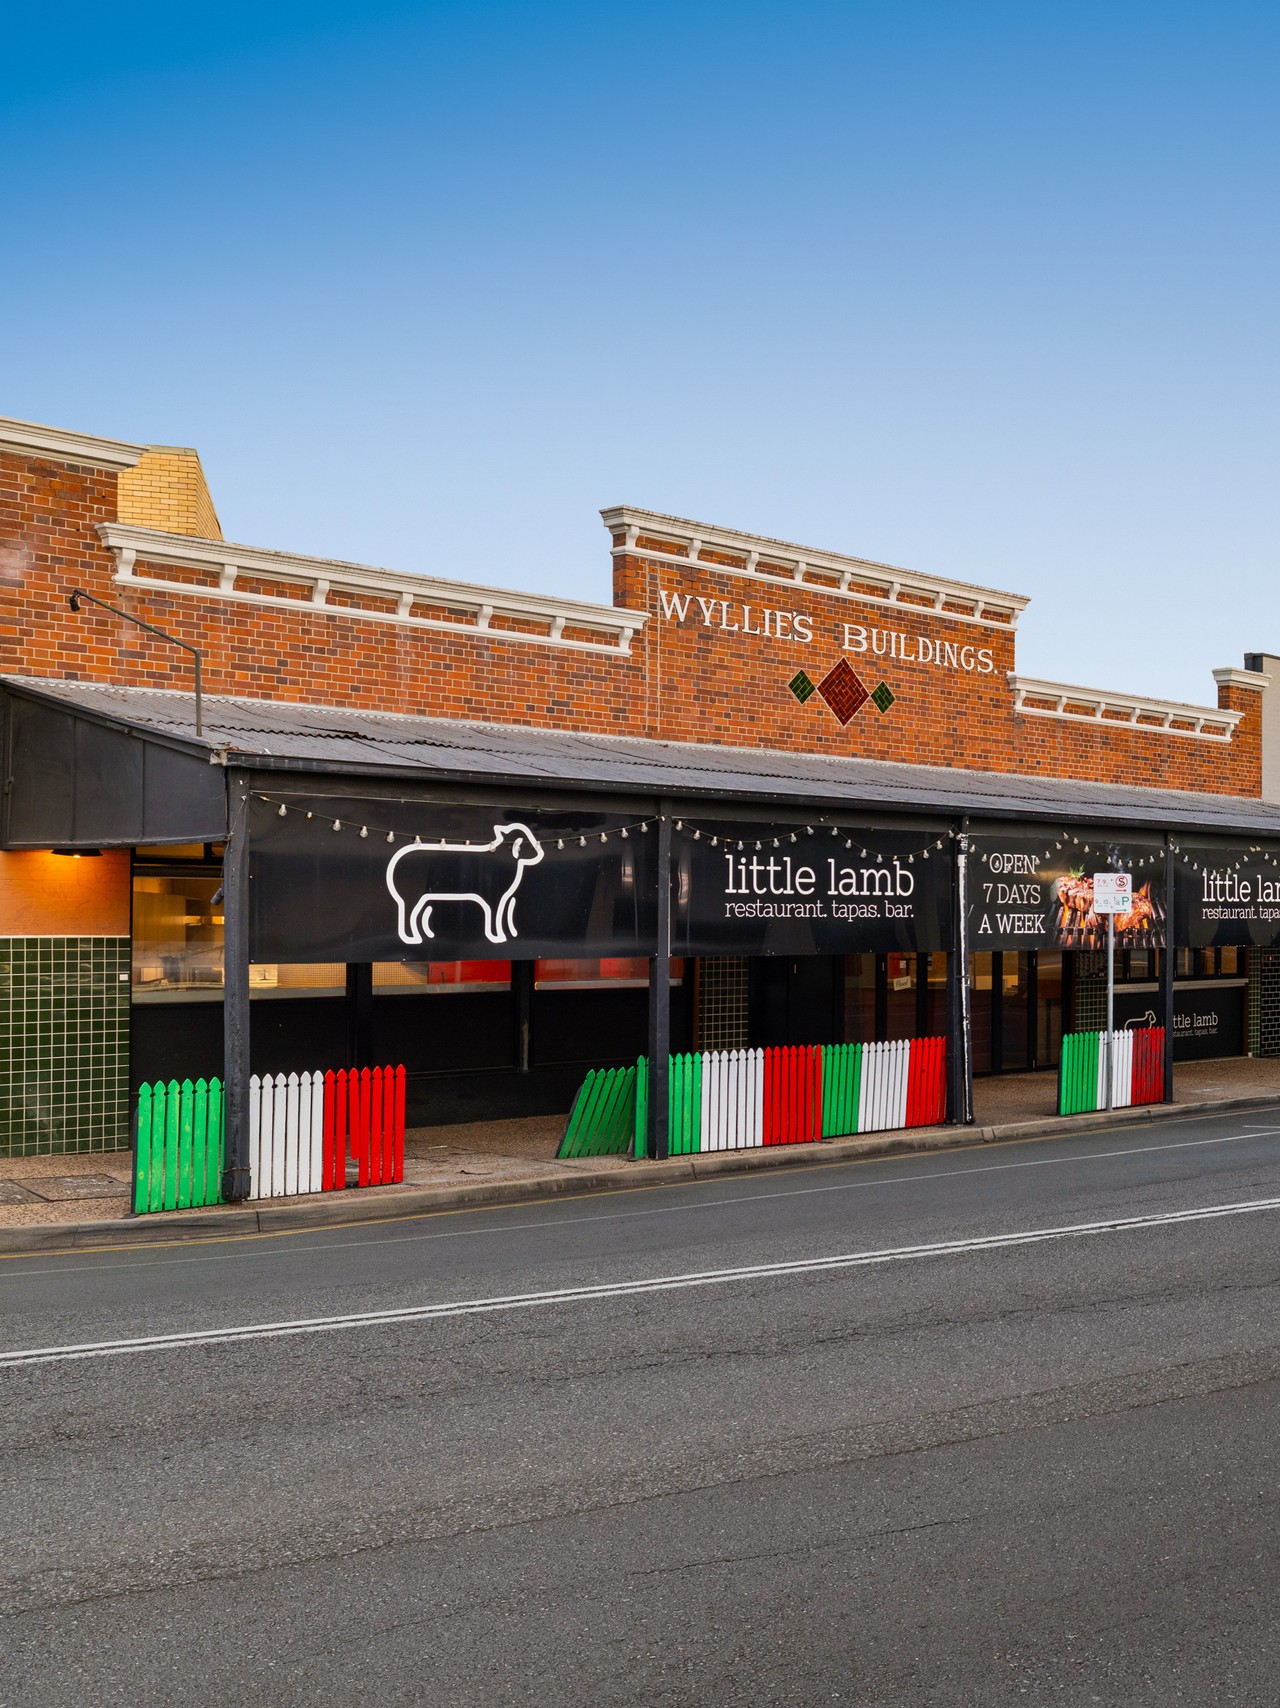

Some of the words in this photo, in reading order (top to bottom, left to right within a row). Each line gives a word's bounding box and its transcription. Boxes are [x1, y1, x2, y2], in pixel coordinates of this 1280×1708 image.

[659, 590, 813, 643] WYLLIE'S
[842, 623, 998, 675] BUILDINGS.
[989, 853, 1037, 875] OPEN
[725, 854, 816, 895] little
[827, 858, 915, 897] lamb
[983, 883, 994, 904] 7
[996, 883, 1041, 904] DAYS
[1202, 873, 1251, 902] little
[724, 899, 828, 918] restaurant.
[831, 900, 881, 922] tapas.
[884, 900, 915, 918] bar.
[1202, 905, 1258, 920] restaurant.
[978, 913, 993, 934] A
[995, 913, 1046, 934] WEEK
[1172, 1014, 1191, 1029] ttle
[1193, 1011, 1219, 1027] lamb
